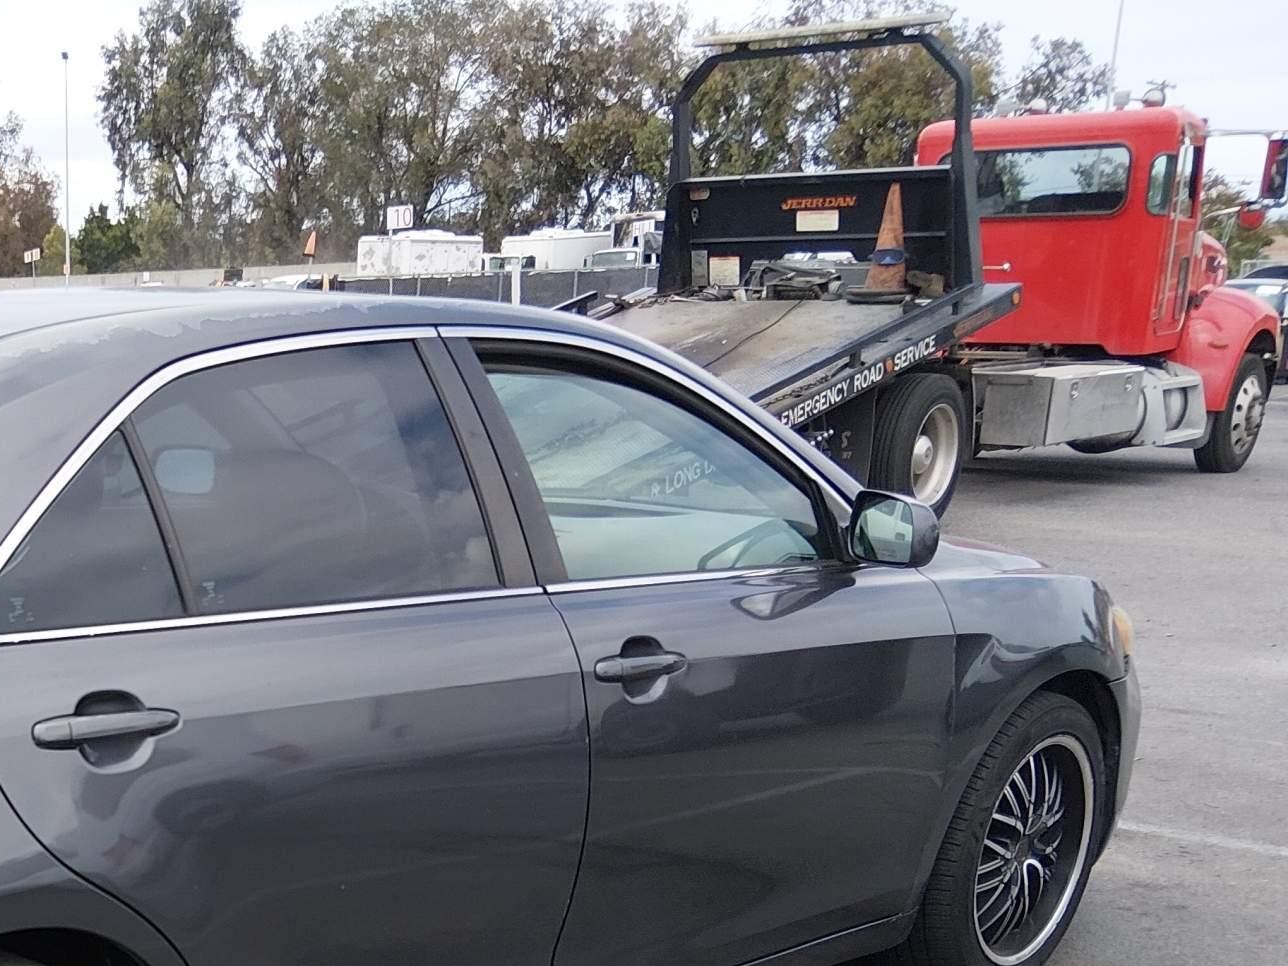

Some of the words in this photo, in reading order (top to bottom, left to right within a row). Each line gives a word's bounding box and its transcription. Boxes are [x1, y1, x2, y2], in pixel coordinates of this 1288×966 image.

[395, 207, 411, 227] 10
[781, 379, 850, 428] EMERGENCY
[854, 363, 885, 393] ROAD
[894, 334, 937, 371] SERVICE
[665, 462, 701, 494] LONG
